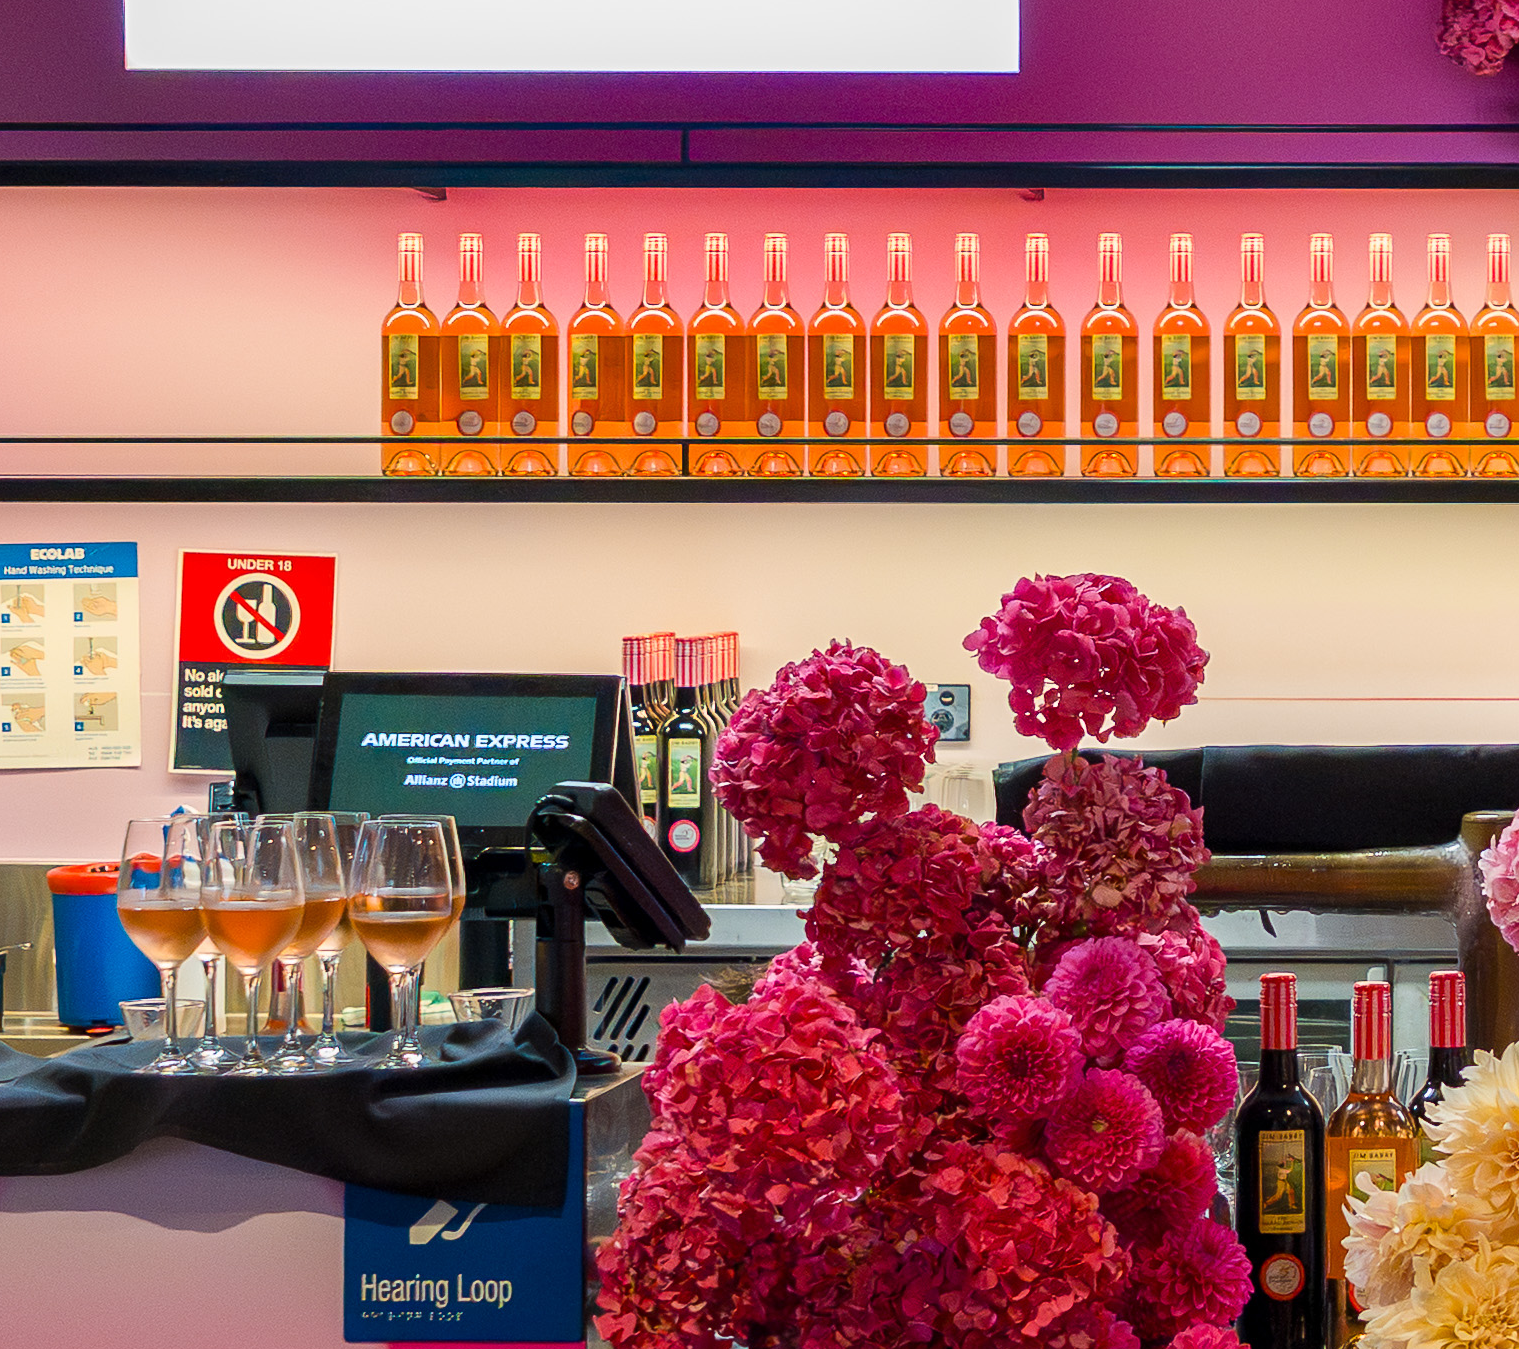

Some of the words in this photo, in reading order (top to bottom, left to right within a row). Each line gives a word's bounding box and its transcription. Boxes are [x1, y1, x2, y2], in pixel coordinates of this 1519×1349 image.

[30, 548, 86, 561] ECOLAB
[3, 565, 28, 575] Hand
[29, 565, 67, 577] Washing
[68, 564, 114, 576] Technique
[227, 558, 274, 571] UNDER
[277, 560, 292, 572] 18
[184, 668, 205, 682] No
[184, 684, 213, 698] sold
[182, 702, 225, 716] anyon
[182, 715, 203, 729] It's
[360, 732, 470, 748] AMERICAN
[474, 734, 570, 750] EXPRESS
[406, 756, 438, 764] Official
[438, 756, 475, 766] Payment
[476, 757, 508, 765] Partner
[509, 757, 520, 765] of
[403, 774, 449, 786] Allianz
[466, 775, 518, 787] Stadium
[361, 1273, 449, 1309] Hearing
[457, 1273, 513, 1309] Loop
